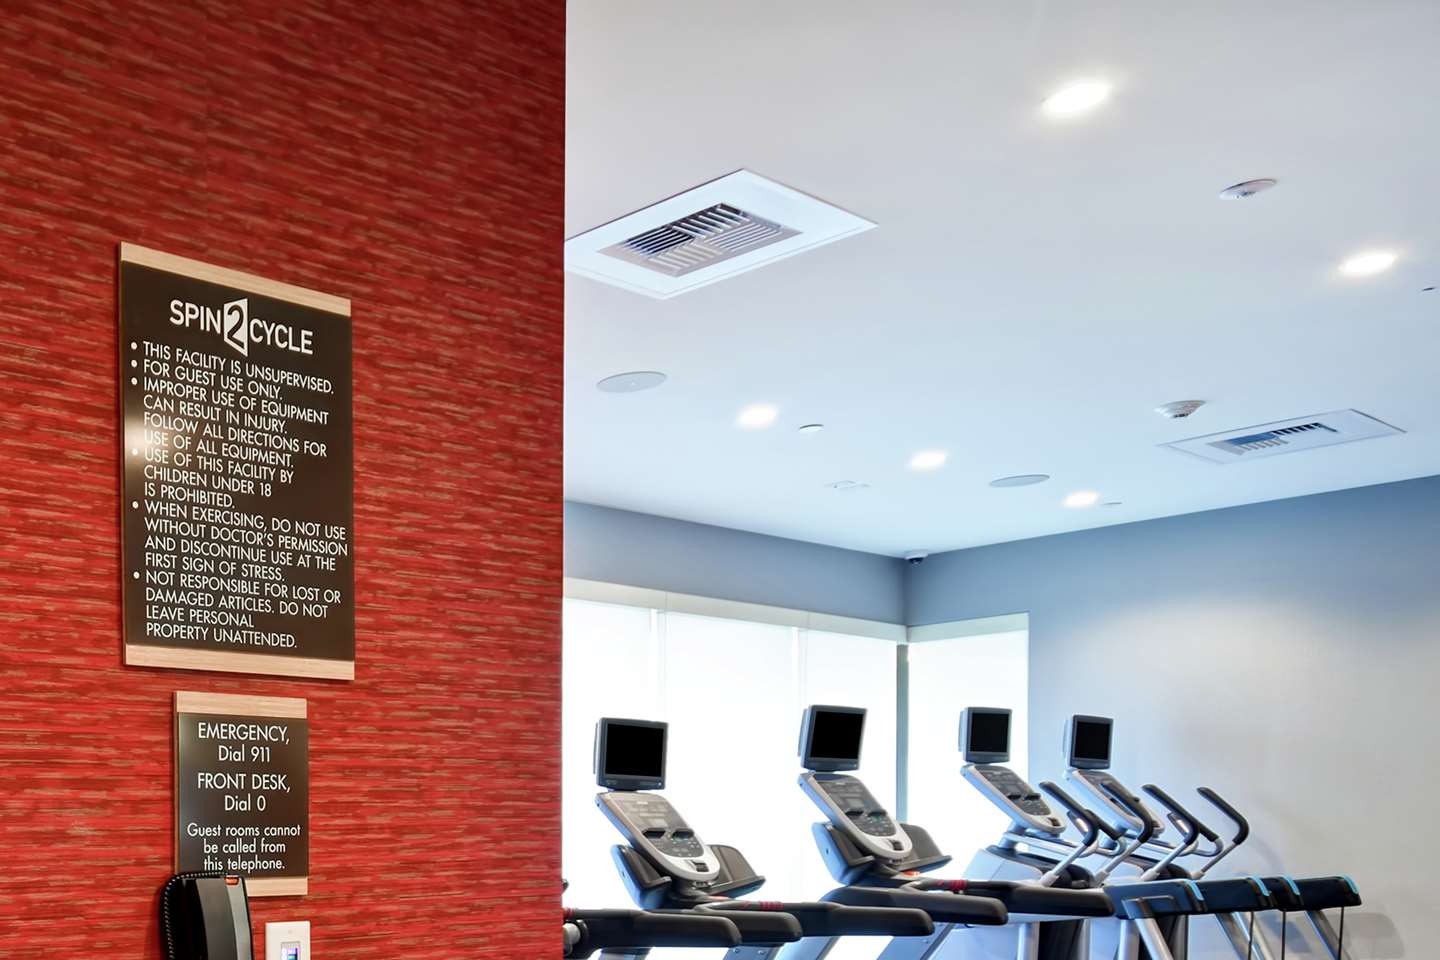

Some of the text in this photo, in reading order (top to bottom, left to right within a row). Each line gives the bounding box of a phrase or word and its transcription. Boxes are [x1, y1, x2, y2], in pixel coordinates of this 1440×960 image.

[143, 341, 334, 393] THIS FACILITY IS UNSUPERVISED.
[144, 360, 282, 400] FOR GUEST USE ONLY.
[144, 378, 328, 424] IMPROPER USE OF EQUIPMENT
[144, 395, 287, 434] CAN RESULT IN INJURY.
[144, 413, 327, 457] FOLLOW ALL DIRECTIONS FOR
[145, 430, 294, 468] USE OF ALL EQUIPMENT.
[144, 465, 271, 497] CHILDREN UNDER 18
[145, 448, 293, 484] USE OF THIS FACILITY BY
[145, 482, 235, 508] IS PROHIBITED.
[145, 500, 346, 540] WHEN EXERCISING, DO NOT USE
[144, 517, 347, 556] WITHOUT DOCTOR'S PERMISSION
[145, 536, 335, 571] AND DISCONTINUE USE AT THE
[146, 553, 285, 581] FIRST SIGN OF STRESS.
[146, 570, 340, 603] NOT RESPONSIBLE FOR LOST OR
[146, 588, 328, 618] DAMAGED ARTICLES. DO NOT
[146, 605, 254, 627] LEAVE PERSONAL
[146, 623, 297, 648] PROPERTY UNATTENDED.
[198, 723, 289, 745] EMERGENCY,
[219, 744, 270, 762] Dial 911
[198, 773, 290, 793] FRONT DESK,
[225, 793, 266, 811] Dial 0
[187, 823, 300, 837] Guest rooms cannot
[204, 838, 285, 853] be called from
[204, 856, 285, 873] this telephone.
